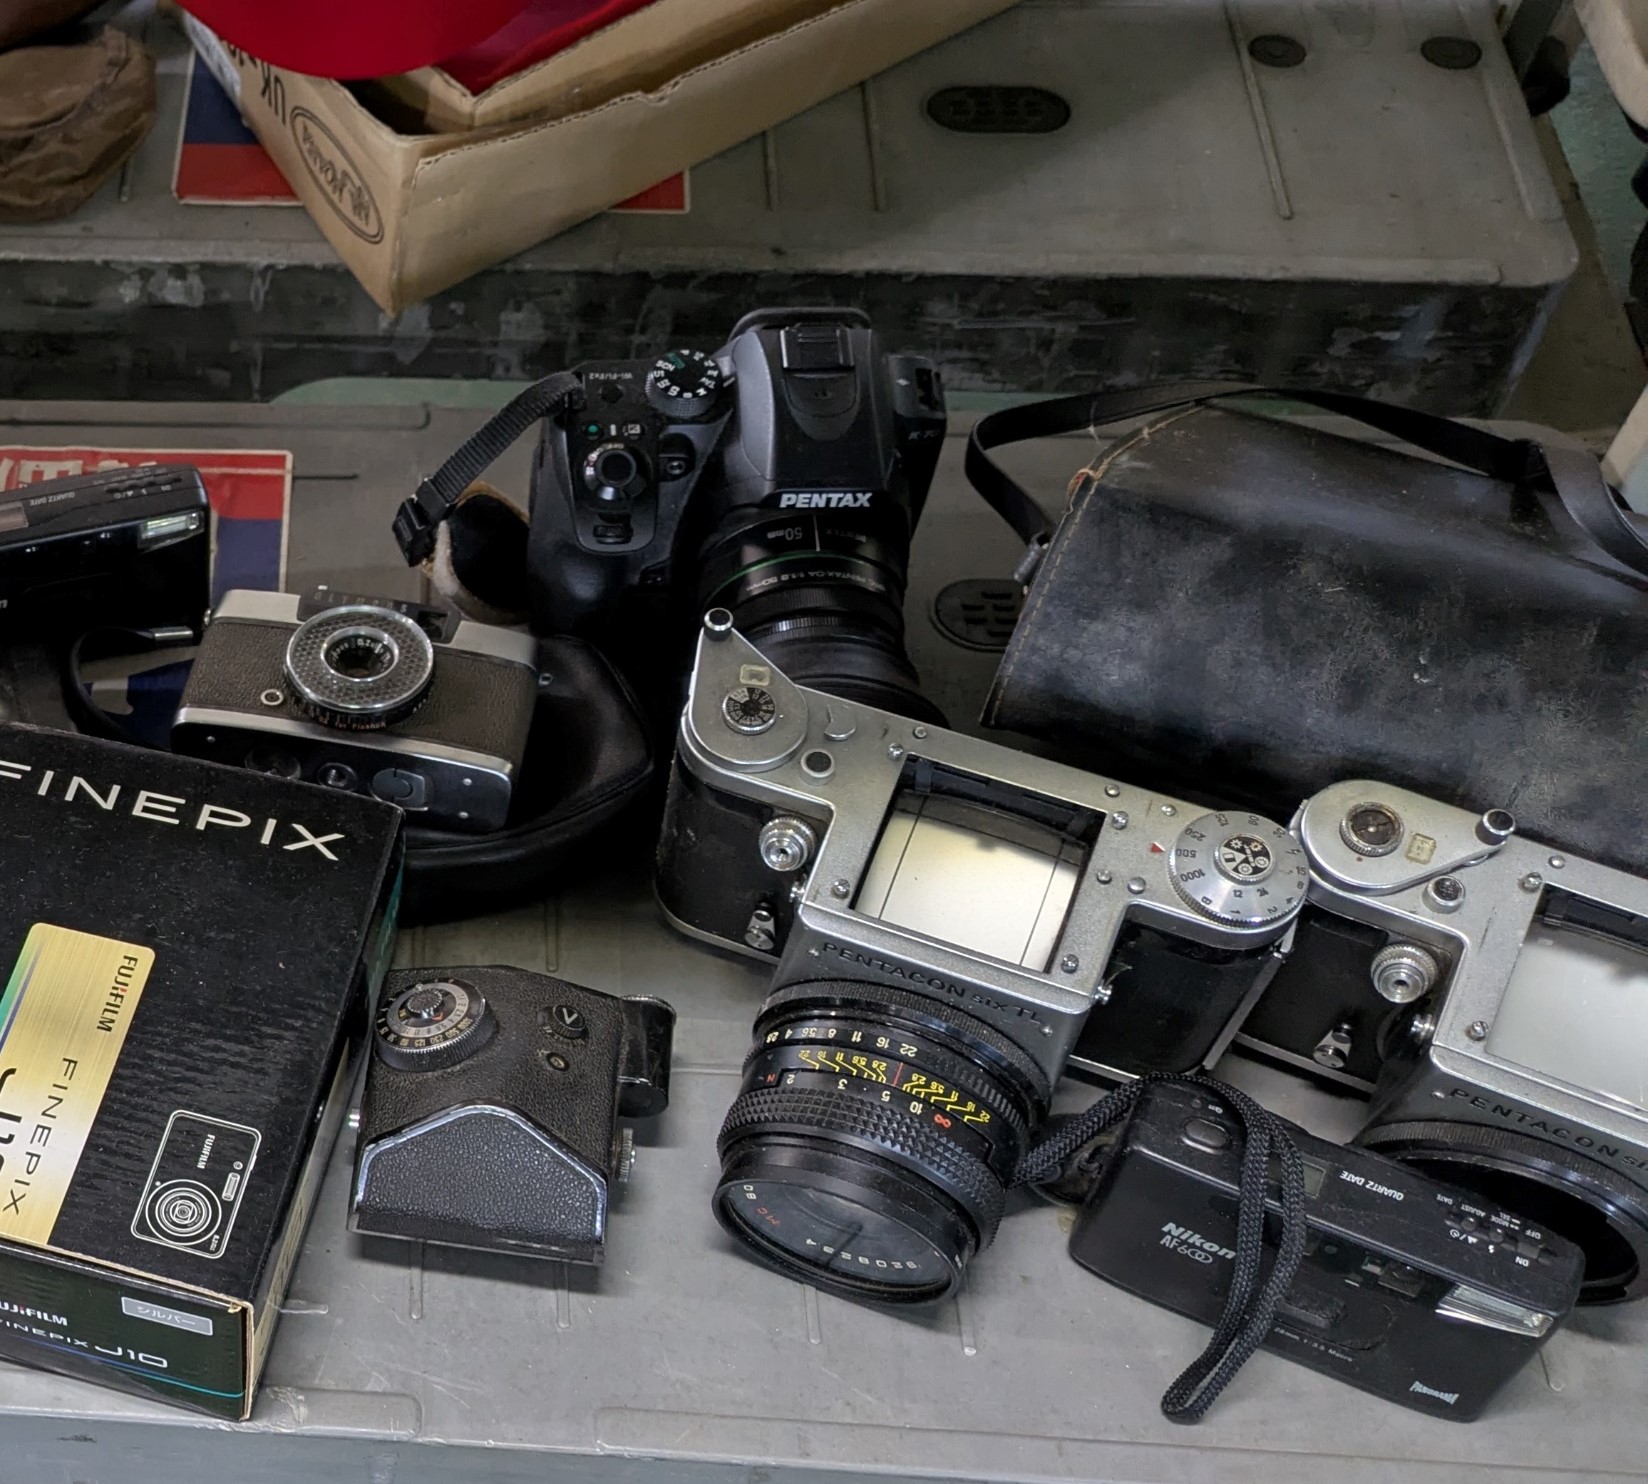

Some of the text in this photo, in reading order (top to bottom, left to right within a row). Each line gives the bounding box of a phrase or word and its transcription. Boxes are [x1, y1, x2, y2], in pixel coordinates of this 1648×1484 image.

[779, 493, 873, 508] PENTAX
[1215, 813, 1229, 828] 125
[1248, 815, 1260, 827] 60
[1184, 827, 1207, 843] 250
[1272, 827, 1287, 839] 30
[1175, 848, 1197, 859] 500
[1179, 868, 1206, 883] 1000
[1232, 888, 1244, 899] 12
[824, 942, 967, 998] PENTACON
[1008, 1006, 1042, 1024] TL
[96, 953, 139, 1034] FUJIFILM
[784, 1027, 793, 1041] 4
[827, 1027, 837, 1040] 8
[851, 1030, 863, 1044] 11
[875, 1036, 891, 1050] 16
[899, 1042, 918, 1058] 22
[786, 1073, 924, 1116] 2 3 5 10
[1449, 1087, 1621, 1160] PENTACON
[2, 1056, 79, 1217] FINEPIX
[196, 1133, 216, 1171] FUJIFILM
[1339, 1169, 1405, 1202] QUARTZ DATE
[1461, 1202, 1486, 1218] ADJUST
[1161, 1220, 1238, 1261] Nikon
[1525, 1228, 1542, 1240] OFF
[1514, 1255, 1530, 1267] ON
[135, 1304, 197, 1328] シルバー
[94, 1343, 169, 1370] J10
